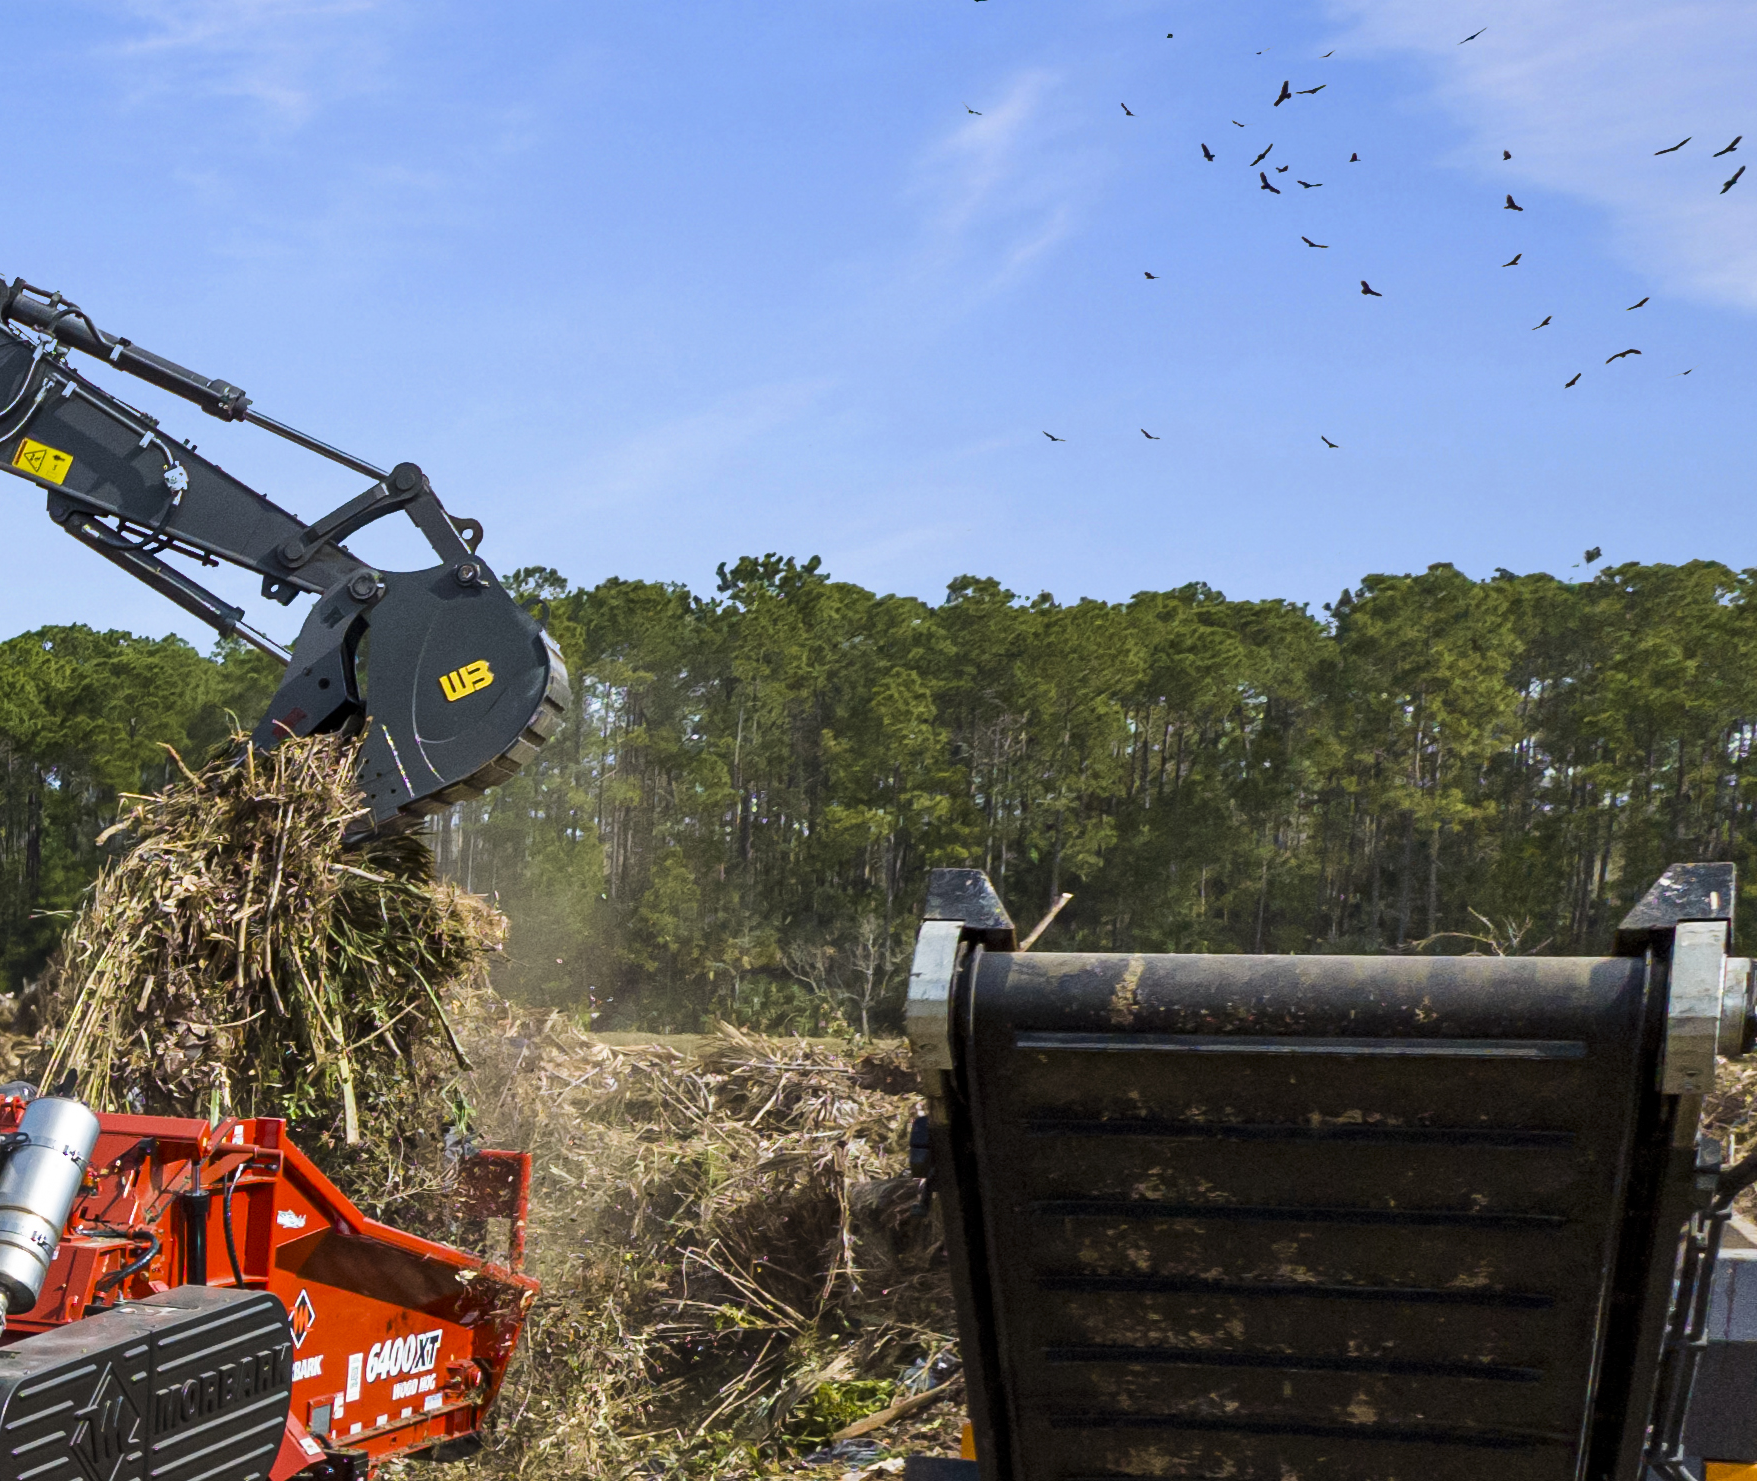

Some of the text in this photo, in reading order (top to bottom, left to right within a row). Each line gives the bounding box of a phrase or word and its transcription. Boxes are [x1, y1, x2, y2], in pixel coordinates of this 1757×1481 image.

[291, 1354, 324, 1382] BARK
[366, 1329, 442, 1383] 6400XT
[155, 1342, 291, 1434] MORBARK
